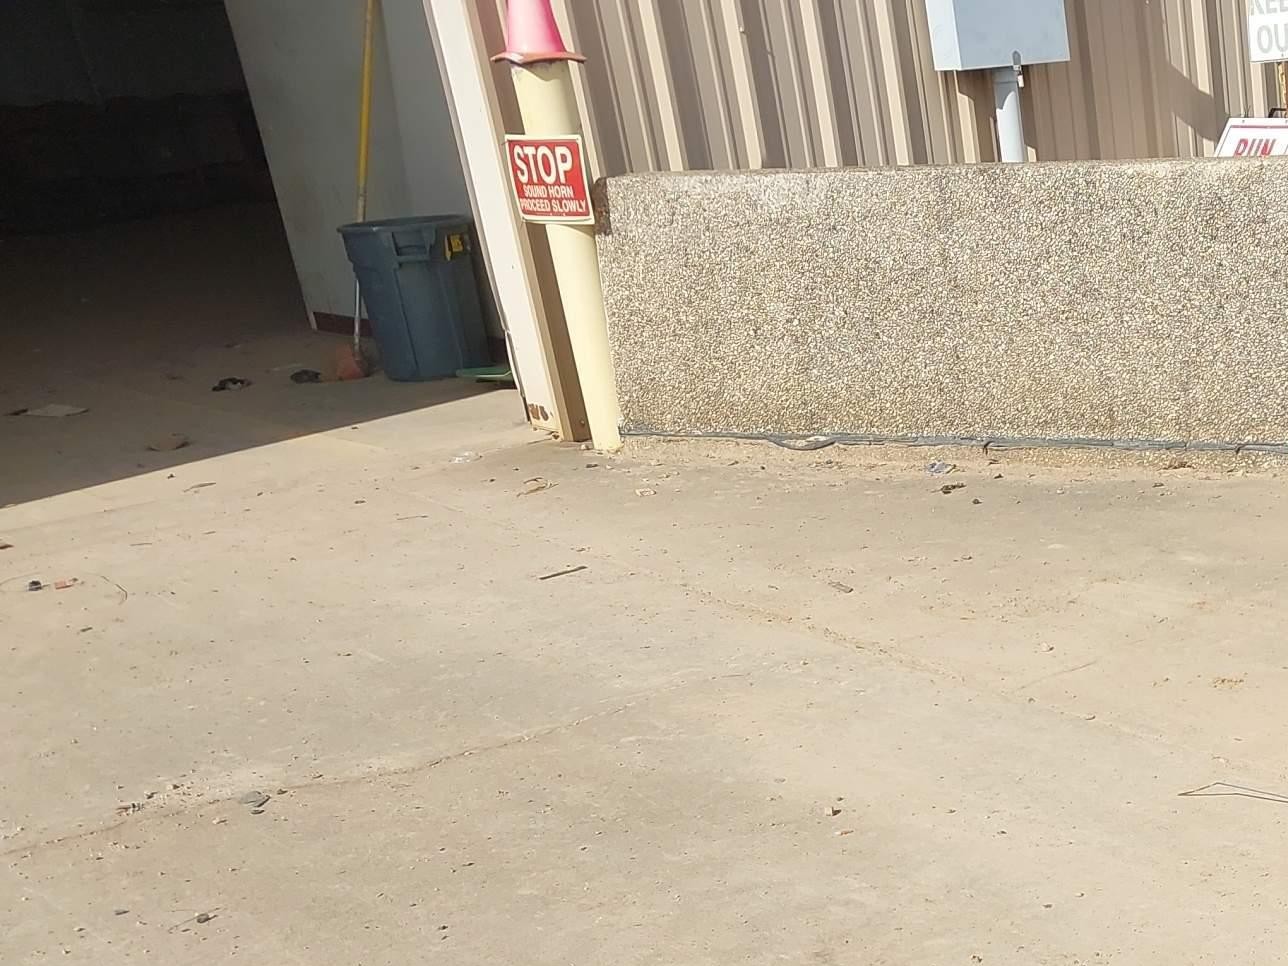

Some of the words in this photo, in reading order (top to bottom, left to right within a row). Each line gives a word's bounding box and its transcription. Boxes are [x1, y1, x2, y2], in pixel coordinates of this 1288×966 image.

[513, 145, 573, 184] STOP
[523, 184, 548, 198] SOUND
[549, 185, 574, 199] HORN
[520, 198, 551, 212] PROCEED
[551, 199, 586, 213] SLOWLY
